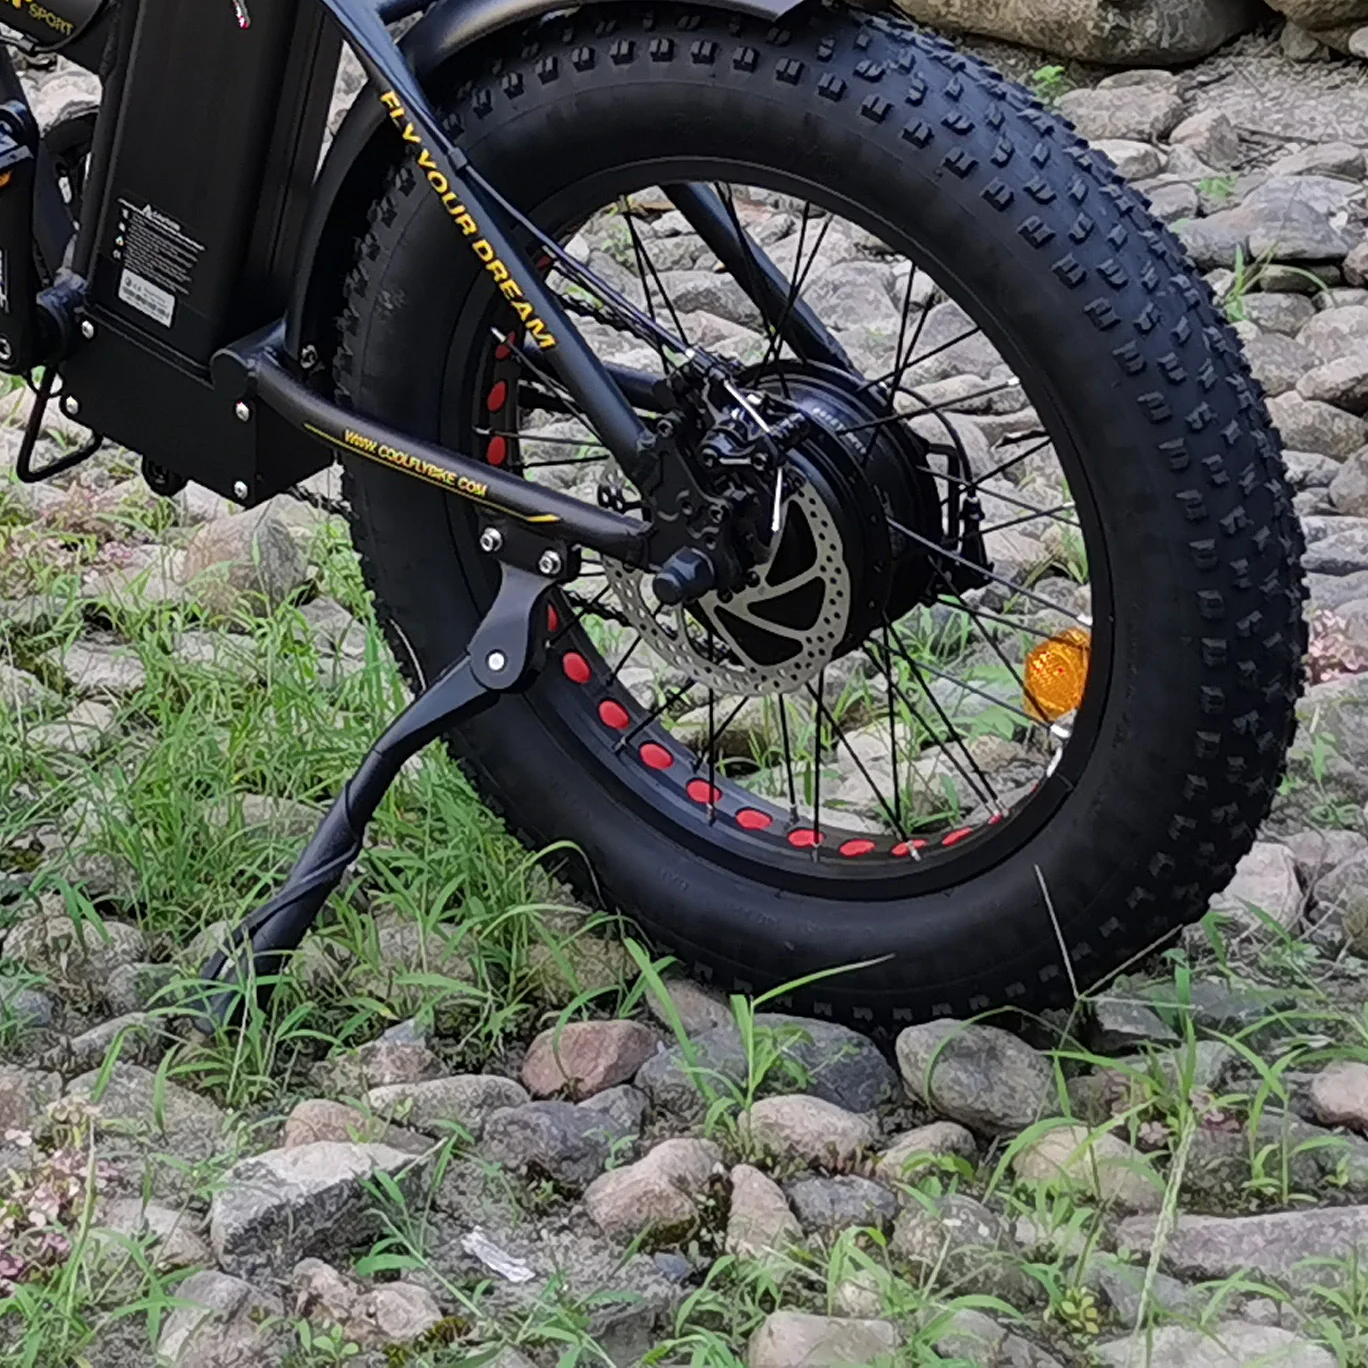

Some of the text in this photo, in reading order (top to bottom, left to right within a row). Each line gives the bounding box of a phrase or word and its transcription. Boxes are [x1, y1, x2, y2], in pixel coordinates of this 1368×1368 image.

[28, 2, 73, 36] SPORT
[417, 148, 479, 236] YOUR
[472, 239, 558, 349] DREAM
